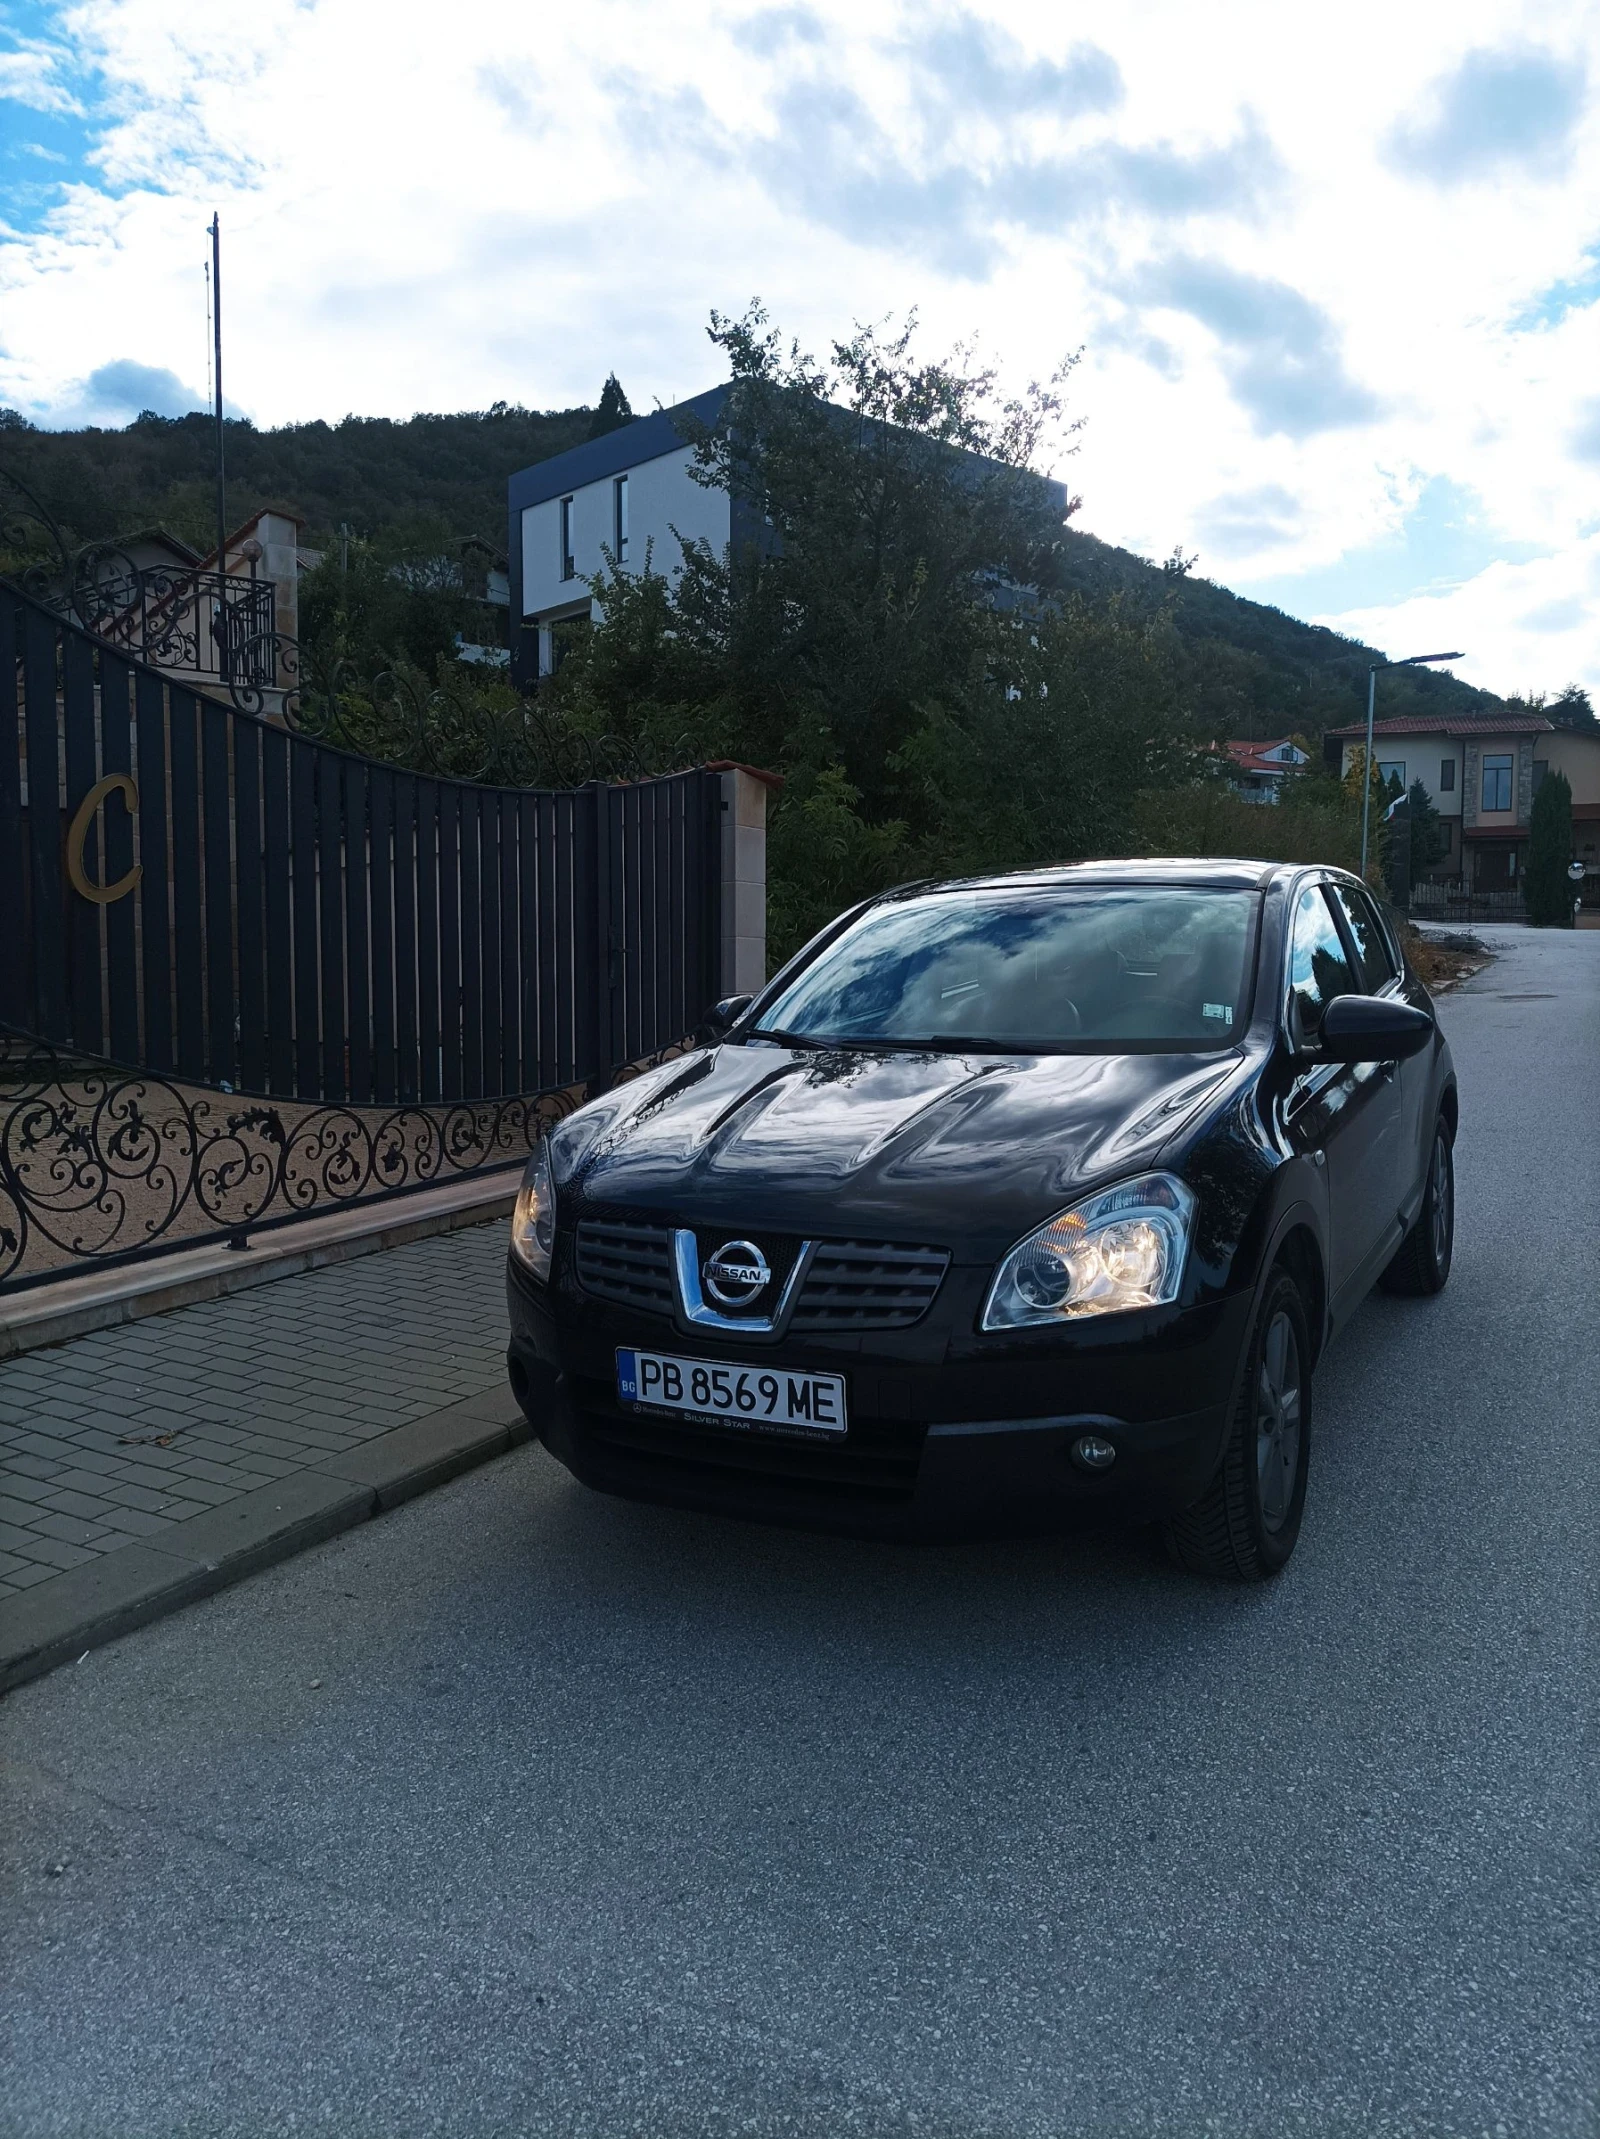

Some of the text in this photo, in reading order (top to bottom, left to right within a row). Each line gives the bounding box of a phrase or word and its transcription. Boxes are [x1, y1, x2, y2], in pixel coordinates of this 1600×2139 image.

[68, 773, 143, 903] C
[707, 1266, 760, 1281] NISSAN
[621, 1380, 636, 1393] BG
[640, 1358, 837, 1424] PB 8569 ME
